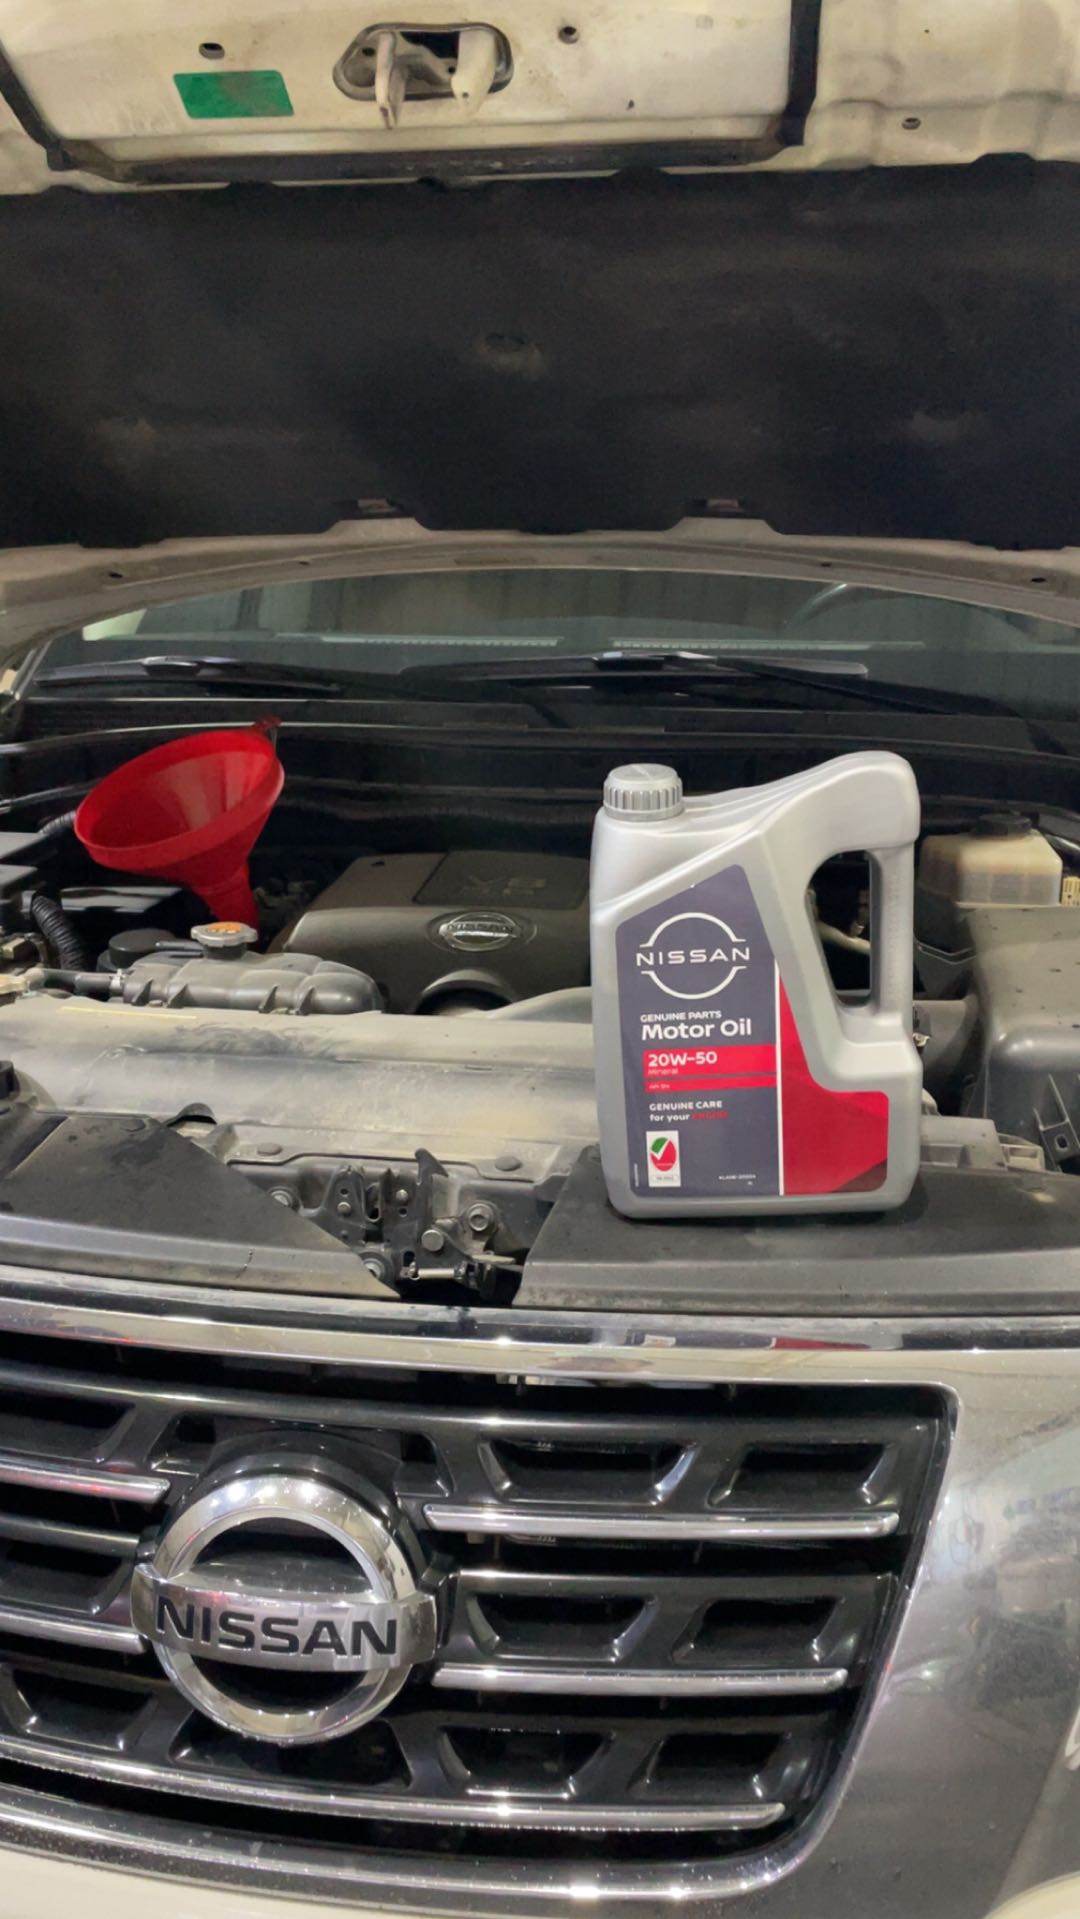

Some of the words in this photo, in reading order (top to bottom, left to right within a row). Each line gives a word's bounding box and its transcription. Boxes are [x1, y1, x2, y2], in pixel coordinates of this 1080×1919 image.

[636, 947, 750, 966] NISSAN
[640, 1012, 686, 1022] GENUINE
[688, 1010, 722, 1019] PARTS
[642, 1023, 715, 1040] Motor
[720, 1018, 751, 1036] Oil
[648, 1051, 718, 1067] 20W-50
[649, 1102, 694, 1111] GENUINE
[695, 1100, 723, 1109] CARE
[649, 1113, 664, 1121] for
[667, 1113, 690, 1122] your
[156, 1596, 397, 1656] NISSAN
